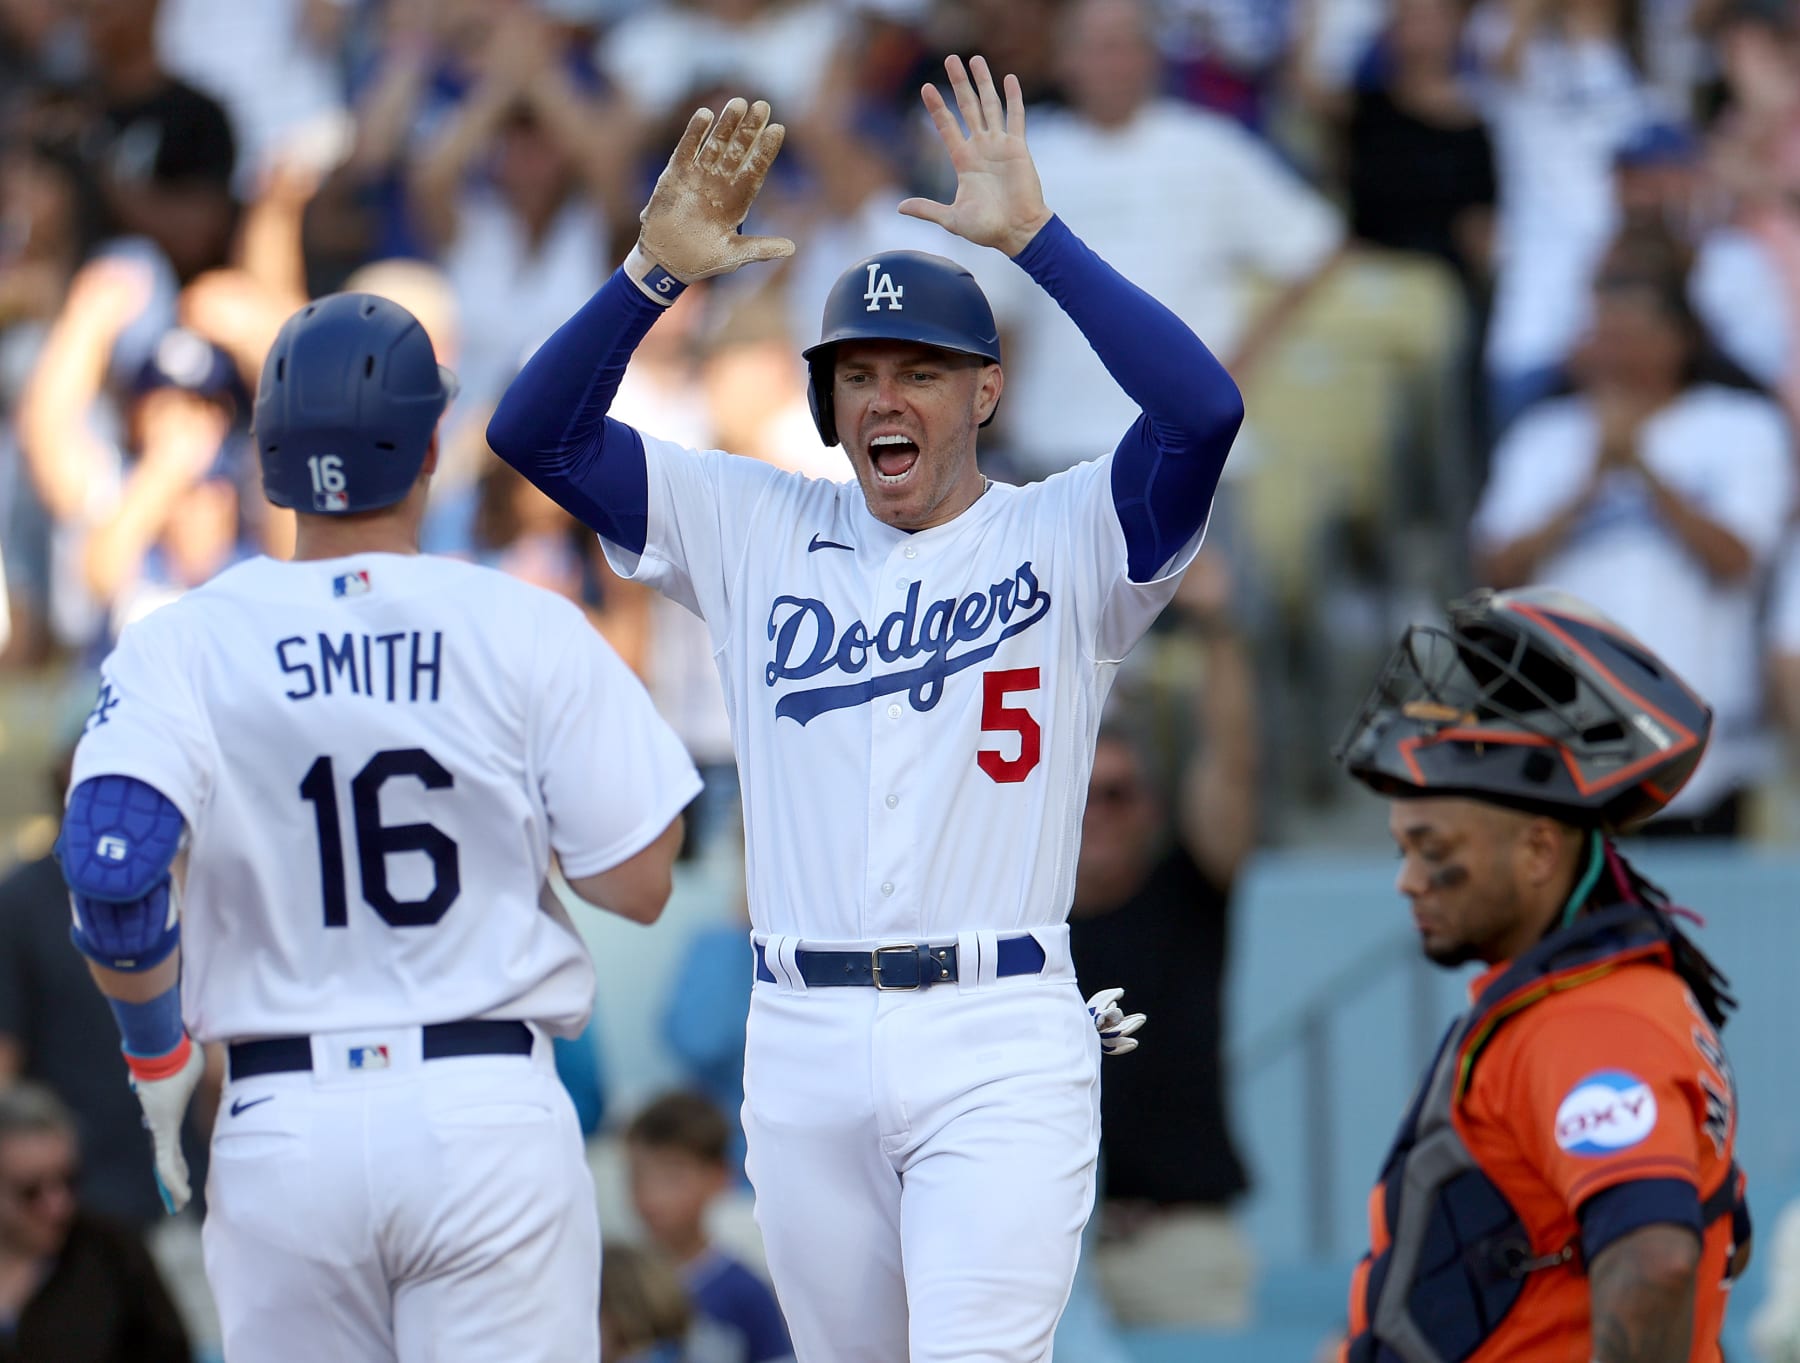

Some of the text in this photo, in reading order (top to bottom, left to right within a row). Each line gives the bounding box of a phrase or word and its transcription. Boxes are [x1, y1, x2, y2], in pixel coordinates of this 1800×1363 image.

[655, 275, 677, 293] 5
[863, 263, 904, 313] LA
[307, 454, 347, 493] 16
[275, 630, 443, 703] SMITH
[765, 560, 1052, 713] Dodgers
[976, 666, 1041, 784] 5
[298, 747, 462, 929] 16
[1558, 1096, 1645, 1138] OXY
